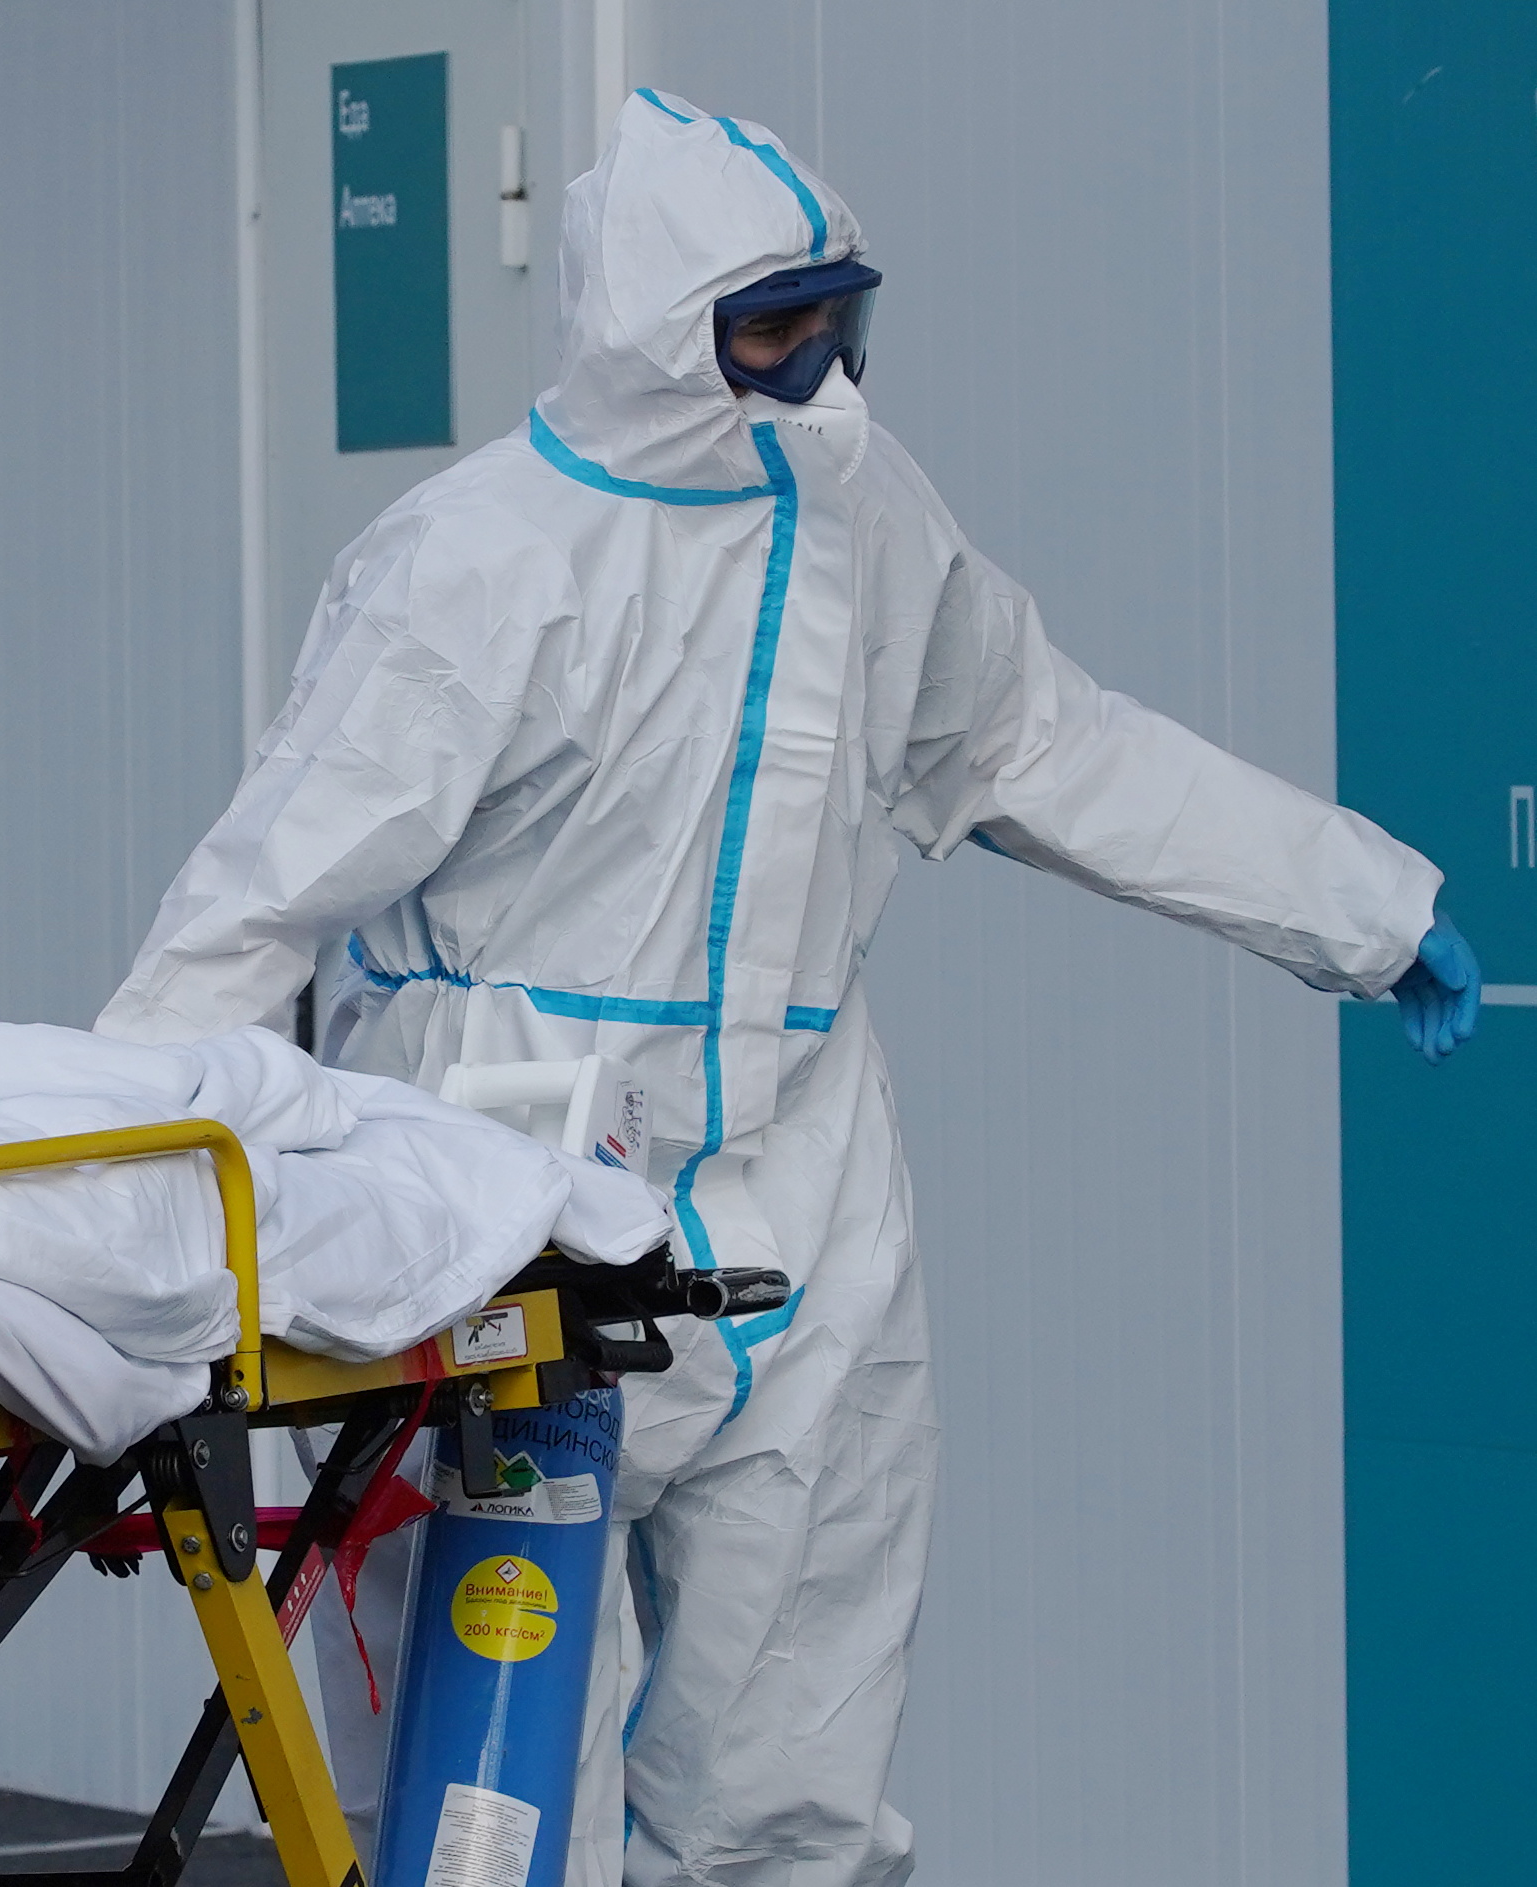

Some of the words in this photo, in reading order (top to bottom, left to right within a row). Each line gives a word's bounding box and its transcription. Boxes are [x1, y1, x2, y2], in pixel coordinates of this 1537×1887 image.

[338, 89, 370, 140] Еда
[338, 185, 398, 228] Аптека
[487, 1502, 534, 1517] ЛОГИКА
[465, 1583, 548, 1602] Внимание!
[464, 1623, 491, 1636] 200
